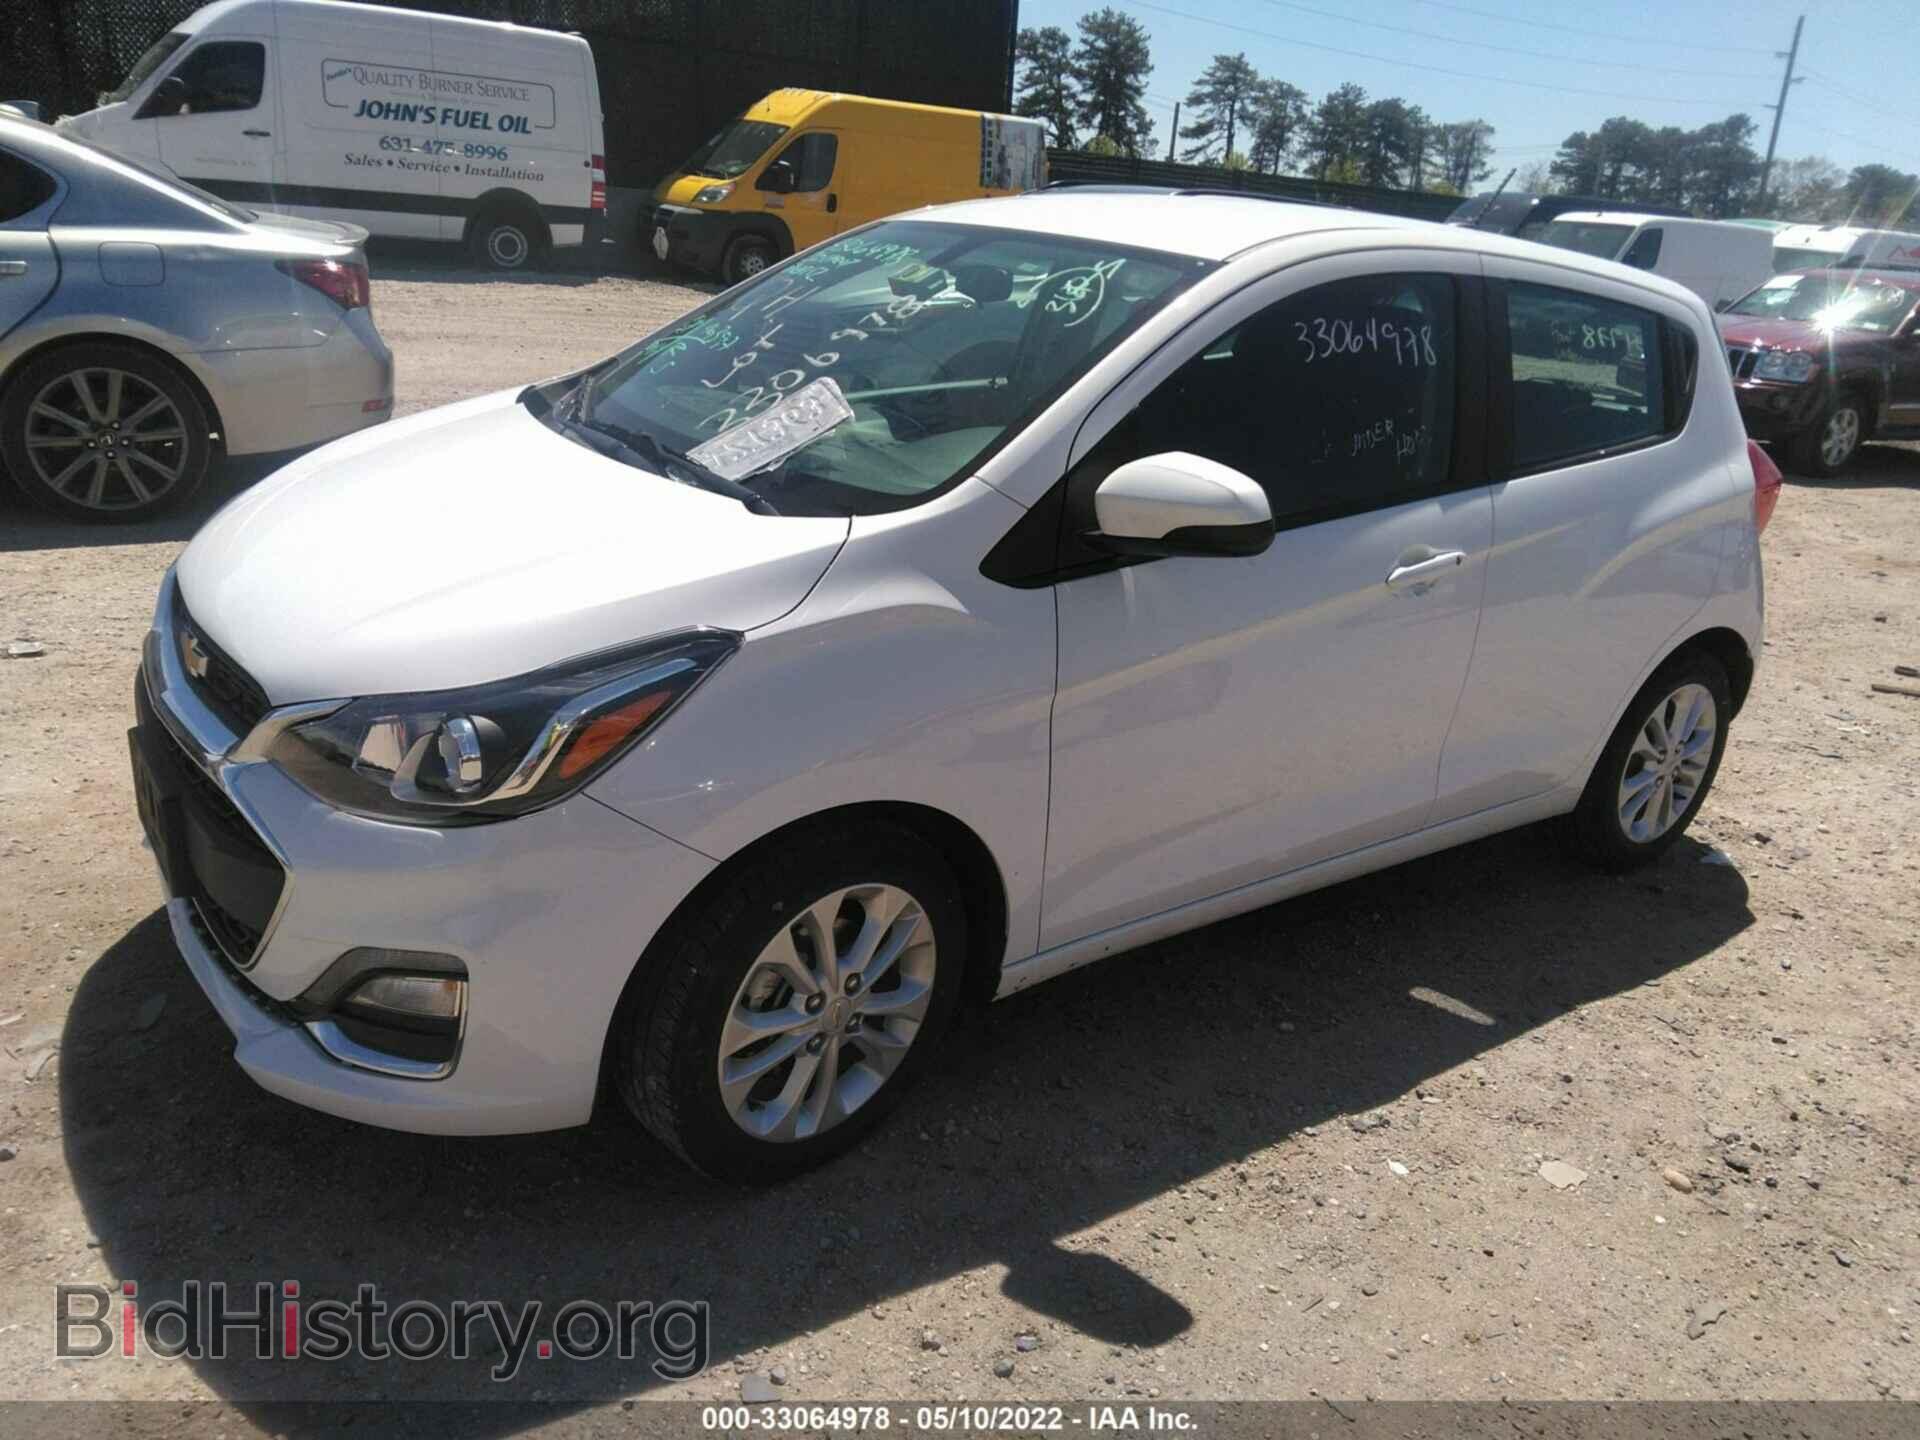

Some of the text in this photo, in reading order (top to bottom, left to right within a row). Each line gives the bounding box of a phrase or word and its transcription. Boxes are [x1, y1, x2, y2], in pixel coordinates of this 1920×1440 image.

[353, 66, 414, 88] QUALITY
[418, 73, 473, 95] BURNER
[477, 80, 530, 101] SERVICE
[354, 99, 436, 124] JOHN'S
[440, 107, 492, 130] FUEL
[498, 114, 532, 134] OIL
[344, 153, 545, 182] Sales Service Installation
[1295, 317, 1437, 366] 33064978
